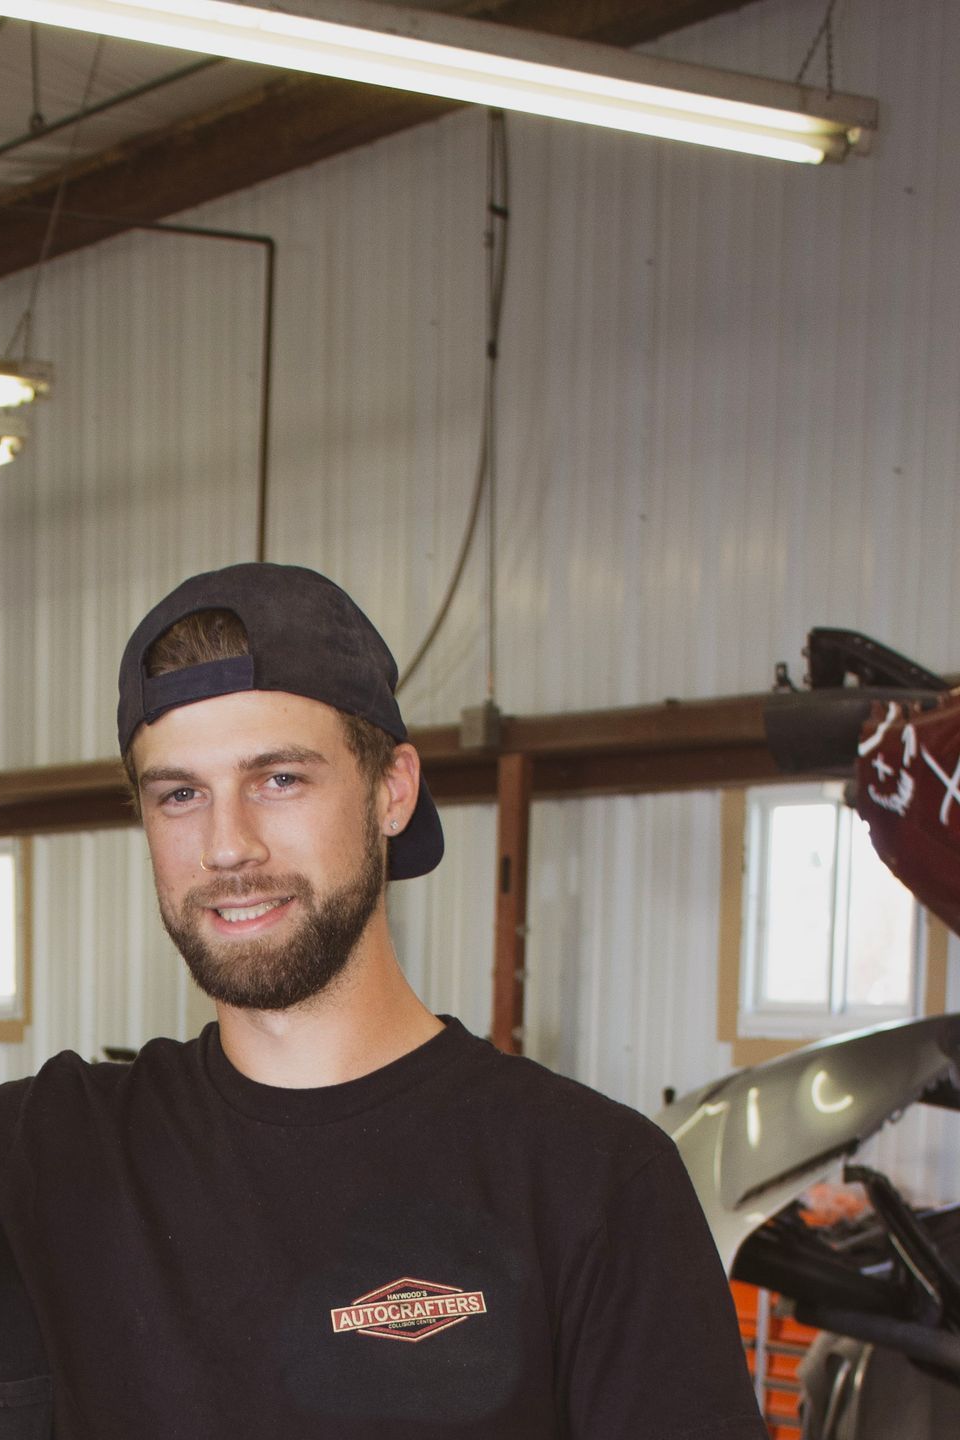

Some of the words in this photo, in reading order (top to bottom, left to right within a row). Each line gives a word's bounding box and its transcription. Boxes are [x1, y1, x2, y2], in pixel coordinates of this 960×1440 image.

[387, 1290, 428, 1301] HAYWOOD'S
[340, 1295, 480, 1329] AUTOCRAFTERS
[388, 1320, 416, 1329] COLLISION
[416, 1318, 436, 1326] CENTER
